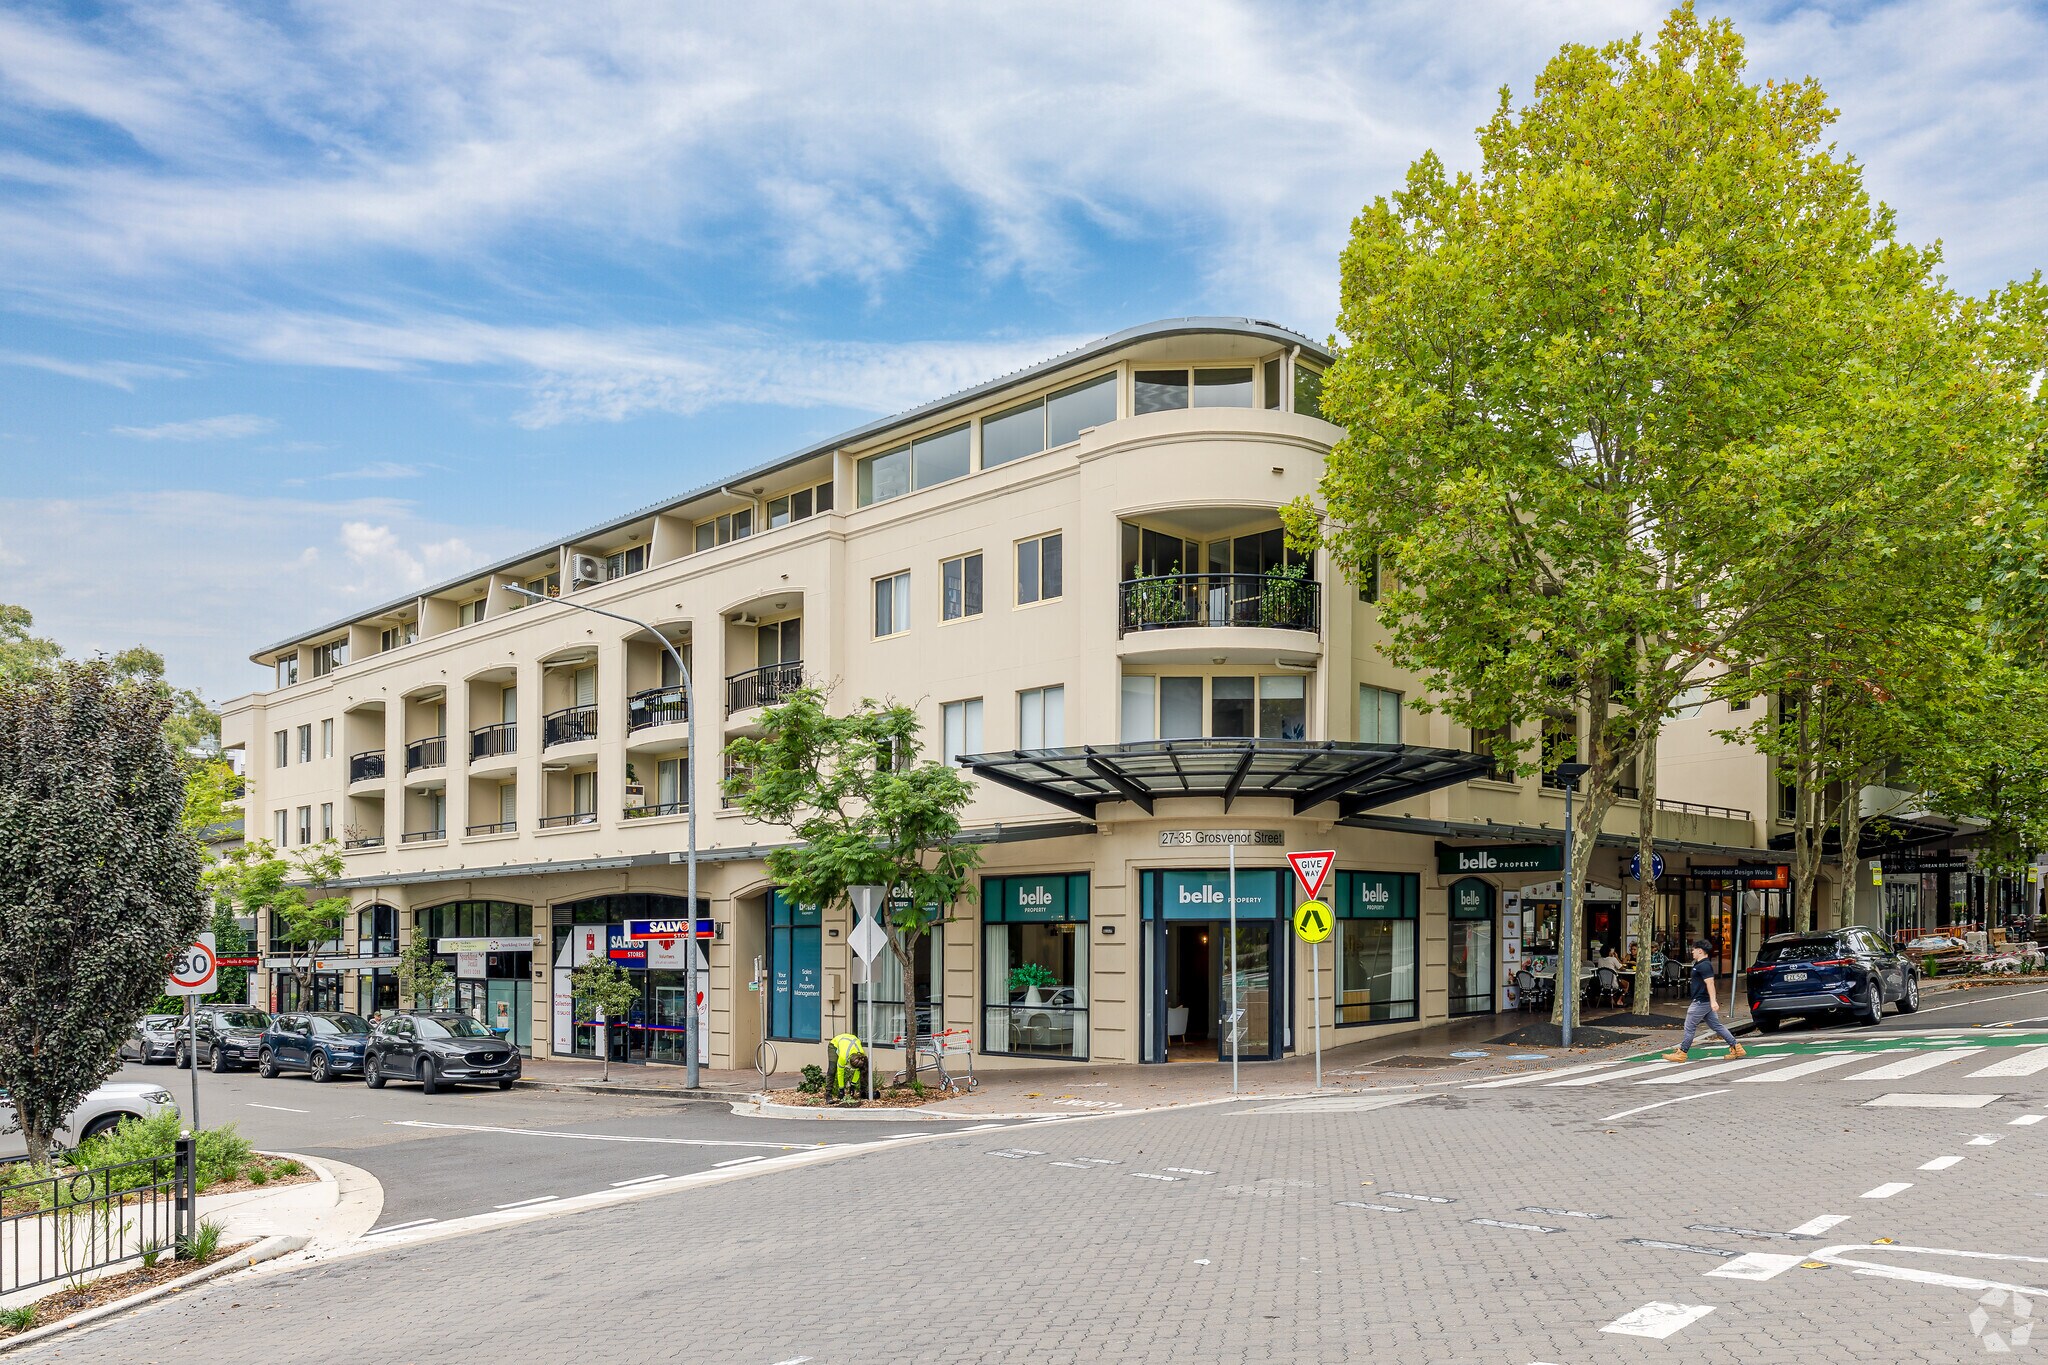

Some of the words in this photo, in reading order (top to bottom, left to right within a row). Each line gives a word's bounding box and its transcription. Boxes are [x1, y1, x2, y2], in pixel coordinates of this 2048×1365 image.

[1161, 832, 1192, 844] 27-35
[1195, 831, 1251, 843] Grosvenor
[1254, 831, 1282, 844] Street
[1301, 859, 1322, 869] GIVE
[1460, 851, 1497, 870] belle
[1305, 869, 1320, 877] WAY
[1734, 869, 1753, 877] Design
[1019, 885, 1052, 905] belle
[1179, 884, 1224, 904] belle
[1362, 882, 1389, 903] belle
[1460, 890, 1480, 905] belle
[649, 921, 689, 933] SALVO
[794, 990, 820, 998] Management
